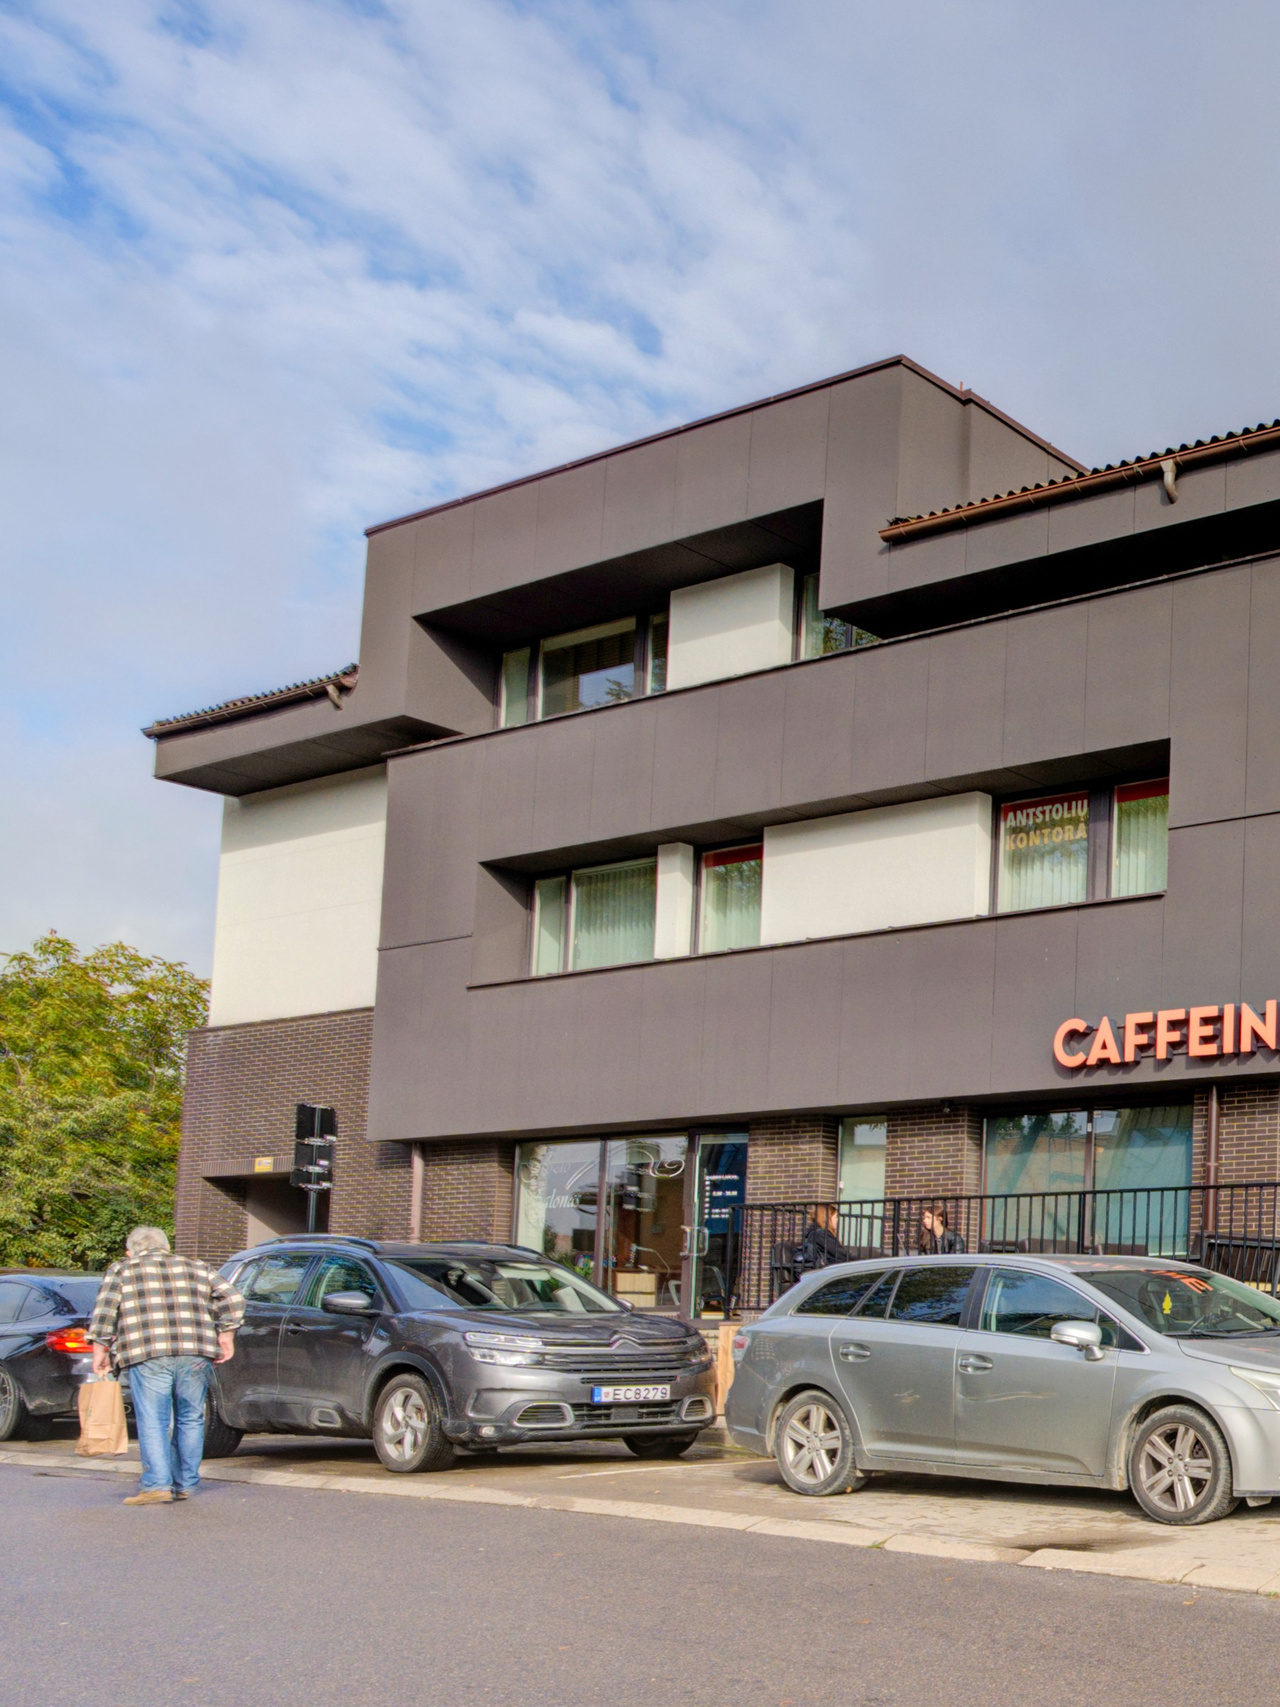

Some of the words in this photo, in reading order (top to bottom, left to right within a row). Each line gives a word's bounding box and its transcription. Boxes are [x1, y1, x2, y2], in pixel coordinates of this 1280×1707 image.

[1006, 799, 1088, 828] ANTSTOLIŲ
[1006, 822, 1088, 850] KONTORA
[613, 1387, 668, 1400] EC8279
